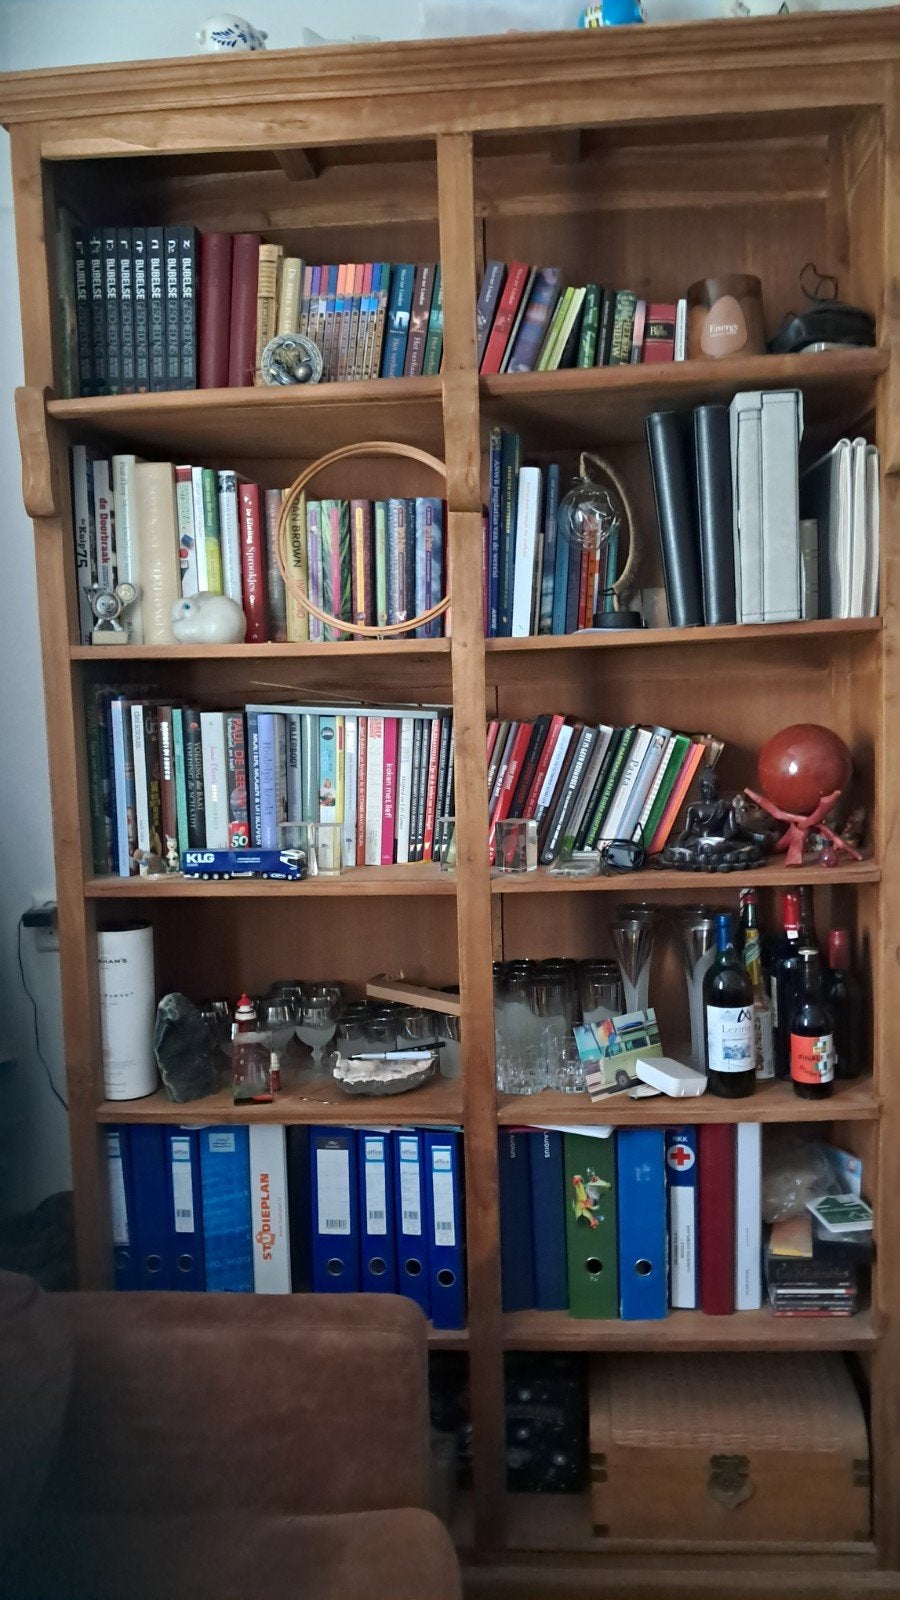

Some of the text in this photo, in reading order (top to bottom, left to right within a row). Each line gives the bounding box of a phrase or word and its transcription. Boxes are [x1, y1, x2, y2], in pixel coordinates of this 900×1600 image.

[76, 260, 86, 300] BIJBELSE
[92, 259, 101, 300] BIJBELSE
[106, 258, 116, 299] BIJBELSE
[121, 259, 130, 300] BIJBELSE
[135, 259, 145, 300] BIJBELSE
[151, 258, 161, 298] BIJBELSE
[167, 258, 177, 298] BIJBELSE
[182, 258, 192, 298] BIJBELSE
[169, 300, 178, 355] GESCHIEDENIS
[183, 299, 192, 355] GESCHIEDENIS
[413, 337, 421, 350] Het
[709, 324, 738, 333] Energy
[99, 498, 107, 510] de
[78, 526, 86, 549] Kuip
[100, 513, 110, 564] Doorbraak
[292, 525, 301, 568] BROWN
[492, 541, 499, 551] de
[246, 547, 257, 592] Sprookjes
[233, 718, 243, 747] PAUL
[289, 721, 297, 769] KILLERBODY
[186, 742, 194, 779] VOEDING
[234, 750, 245, 765] DE
[577, 747, 587, 763] GEEN
[622, 759, 638, 789] Pasta
[188, 791, 196, 828] SCHAADT
[264, 788, 273, 816] kookt
[384, 763, 393, 818] koken met lief!
[186, 853, 215, 863] KLG
[229, 835, 249, 848] 50
[258, 1173, 273, 1260] STUDIEPLAN
